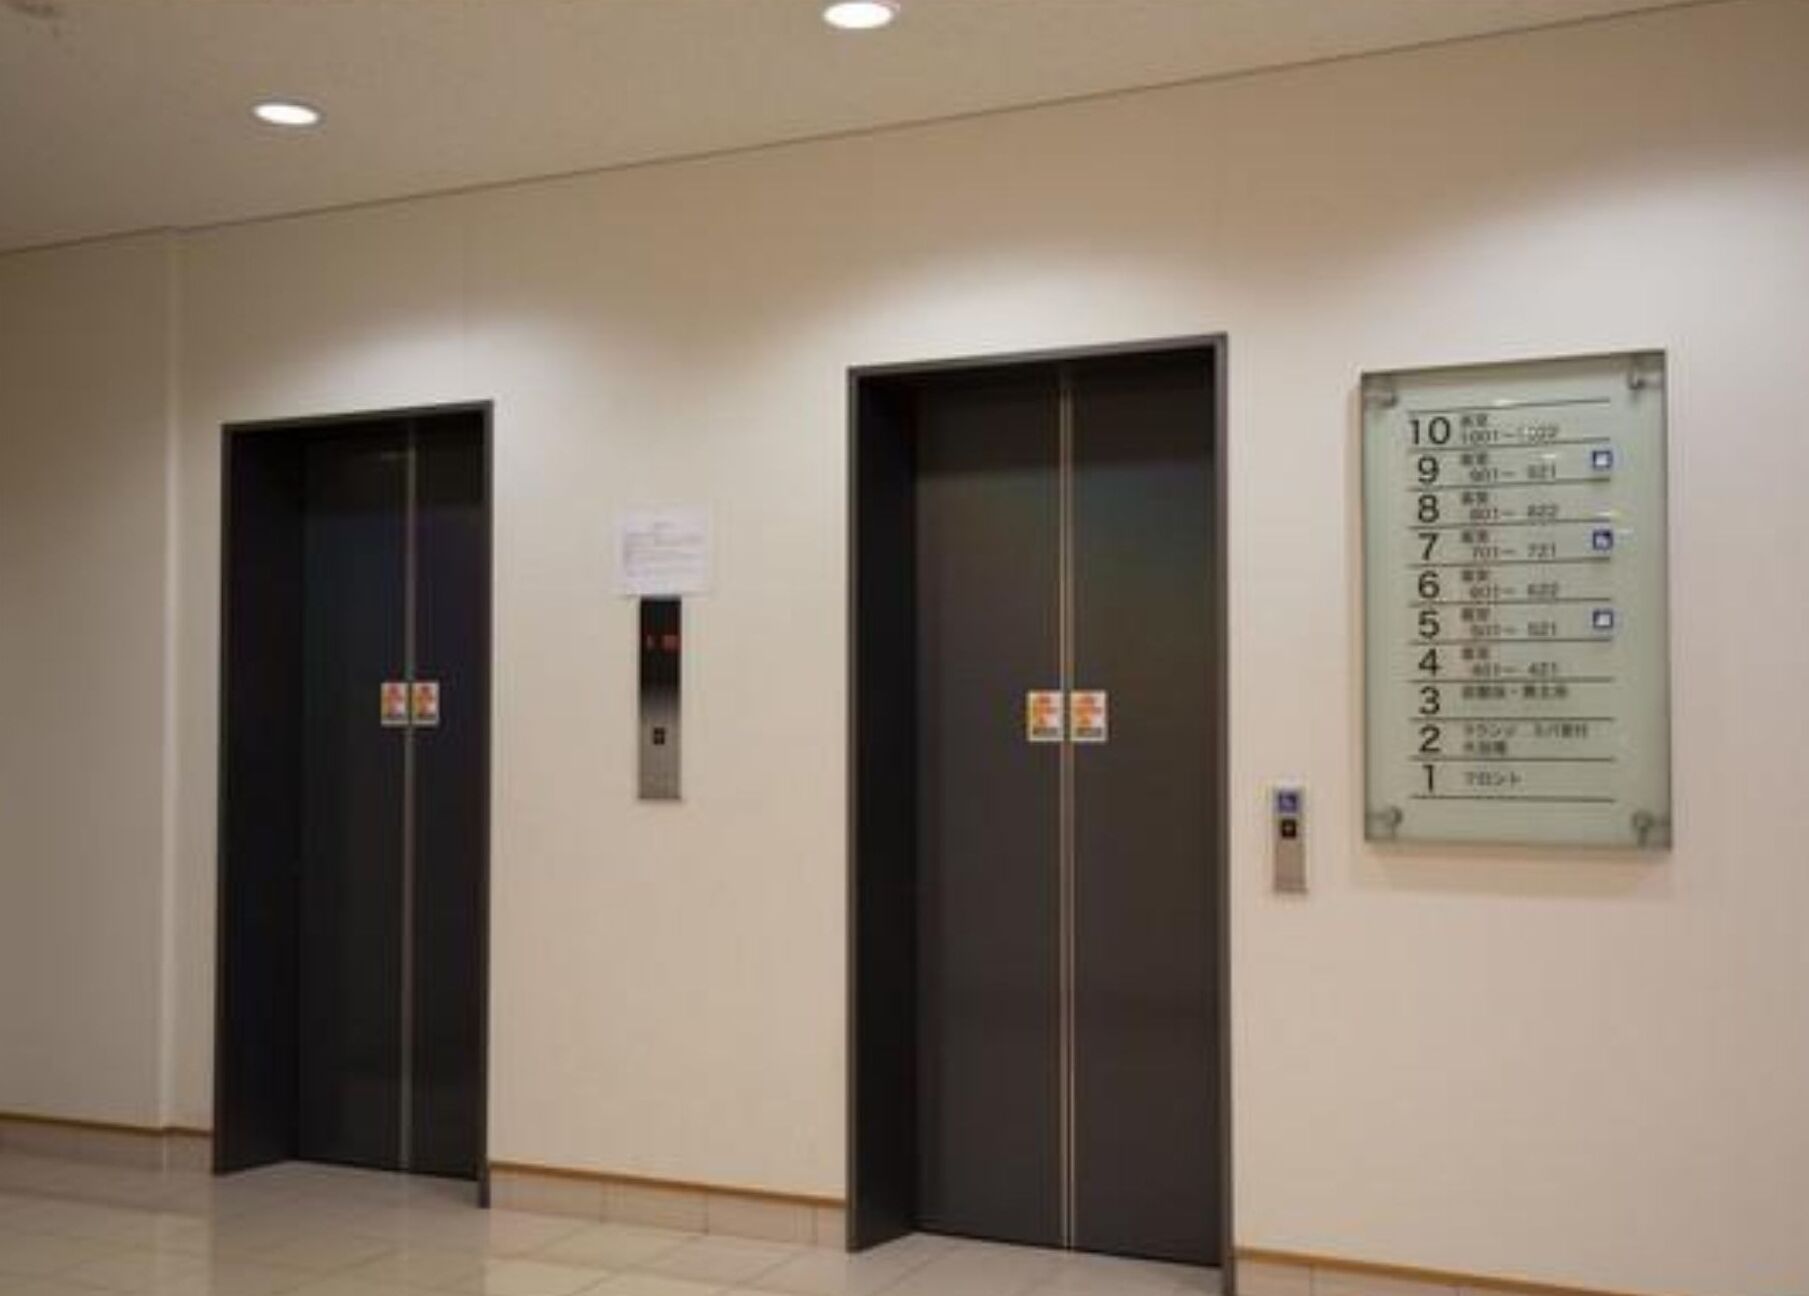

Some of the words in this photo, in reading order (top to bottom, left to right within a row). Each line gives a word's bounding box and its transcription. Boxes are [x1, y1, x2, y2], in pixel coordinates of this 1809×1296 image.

[1410, 416, 1450, 445] 10
[1418, 455, 1439, 484] 9
[1418, 494, 1439, 523] 8
[1418, 532, 1439, 561] 7
[1418, 570, 1440, 599] 6
[1418, 610, 1440, 639] 5
[1418, 648, 1442, 677] 4
[1418, 685, 1441, 715] 3
[1418, 724, 1441, 753] 2
[1422, 763, 1435, 793] 1
